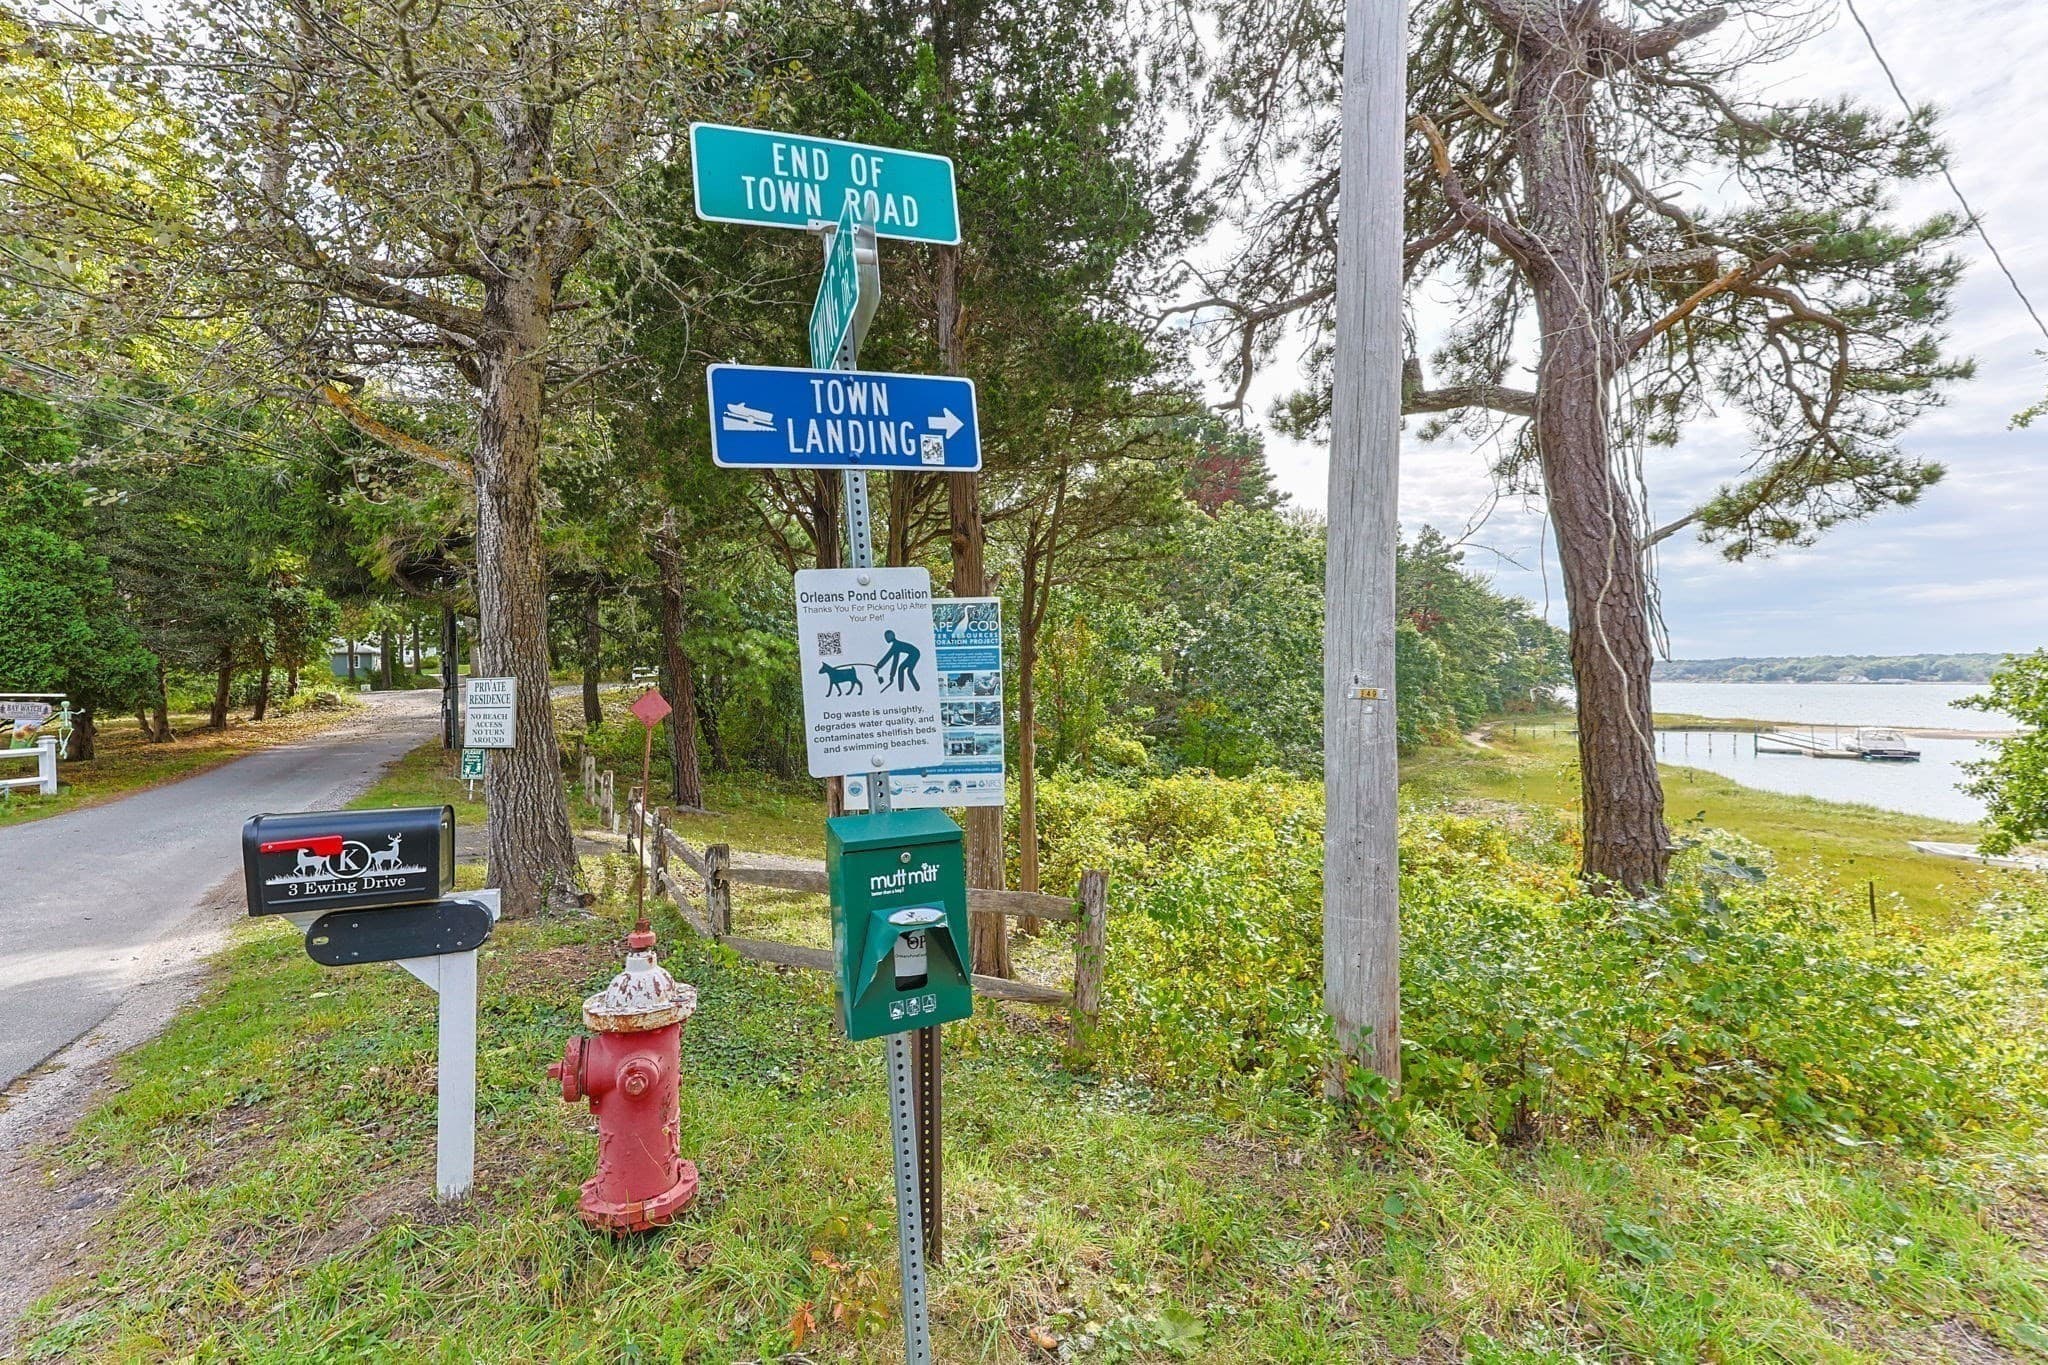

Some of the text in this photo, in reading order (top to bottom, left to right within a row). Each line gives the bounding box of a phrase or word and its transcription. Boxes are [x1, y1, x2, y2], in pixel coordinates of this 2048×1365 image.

[772, 142, 884, 188] END OF
[742, 175, 919, 228] TOWN ROAD
[812, 264, 839, 369] EWING
[811, 379, 889, 417] TOWN
[788, 417, 916, 457] LANDING
[800, 588, 928, 604] Orleans Pond Coalition
[803, 602, 927, 614] Thanks You For Picking Up After
[849, 613, 885, 623] Your Pet!
[933, 620, 999, 633] APE COD
[474, 681, 506, 693] PRIVATE
[469, 694, 511, 705] RESIDENCE
[814, 721, 857, 733] degrades
[859, 720, 883, 729] water
[918, 714, 935, 723] and
[823, 711, 842, 721] Dog
[844, 709, 870, 718] waste
[872, 707, 880, 716] is
[472, 736, 505, 744] AROUND
[813, 725, 937, 744] contaminates shellfish beds
[823, 738, 929, 754] and swimming beaches.
[338, 848, 361, 872] K
[870, 862, 938, 890] mutt mitt
[288, 876, 406, 896] 3 Ewing Drive
